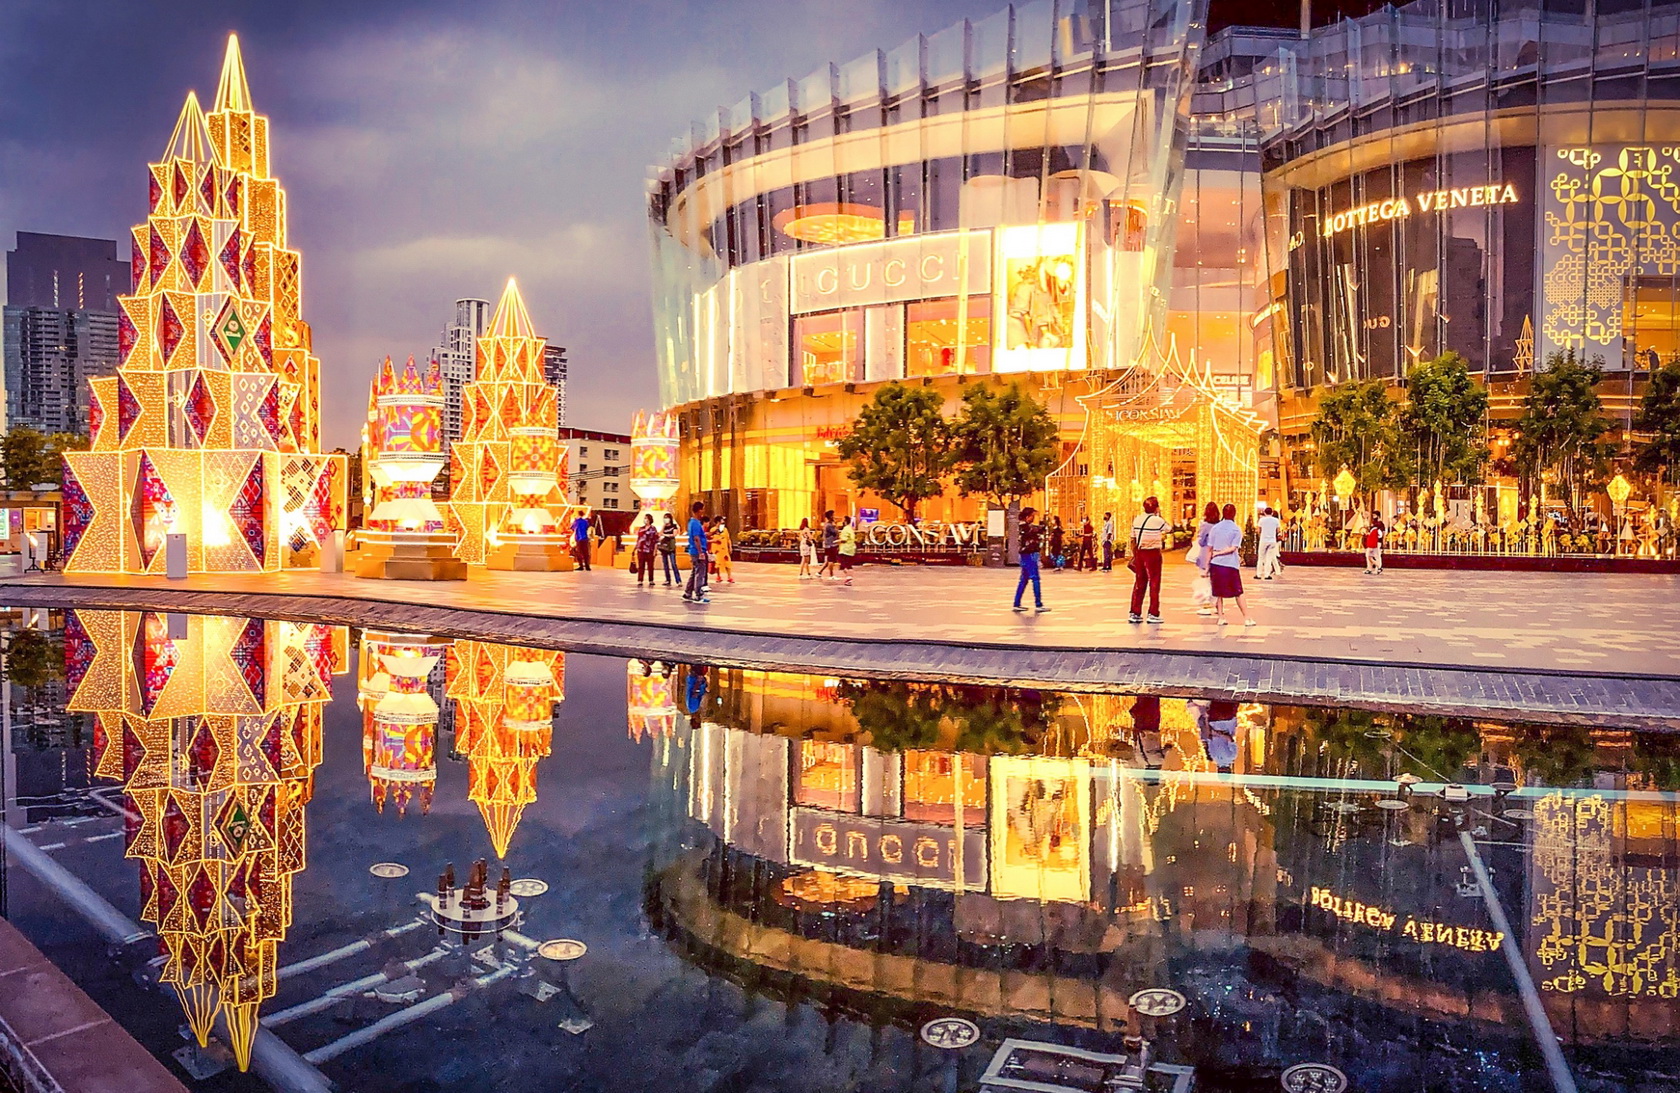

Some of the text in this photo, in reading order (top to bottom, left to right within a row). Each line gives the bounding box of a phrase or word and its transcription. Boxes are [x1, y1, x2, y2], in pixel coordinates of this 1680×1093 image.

[1323, 184, 1519, 238] BOTTEGA VENETA
[817, 253, 962, 296] GUCCI
